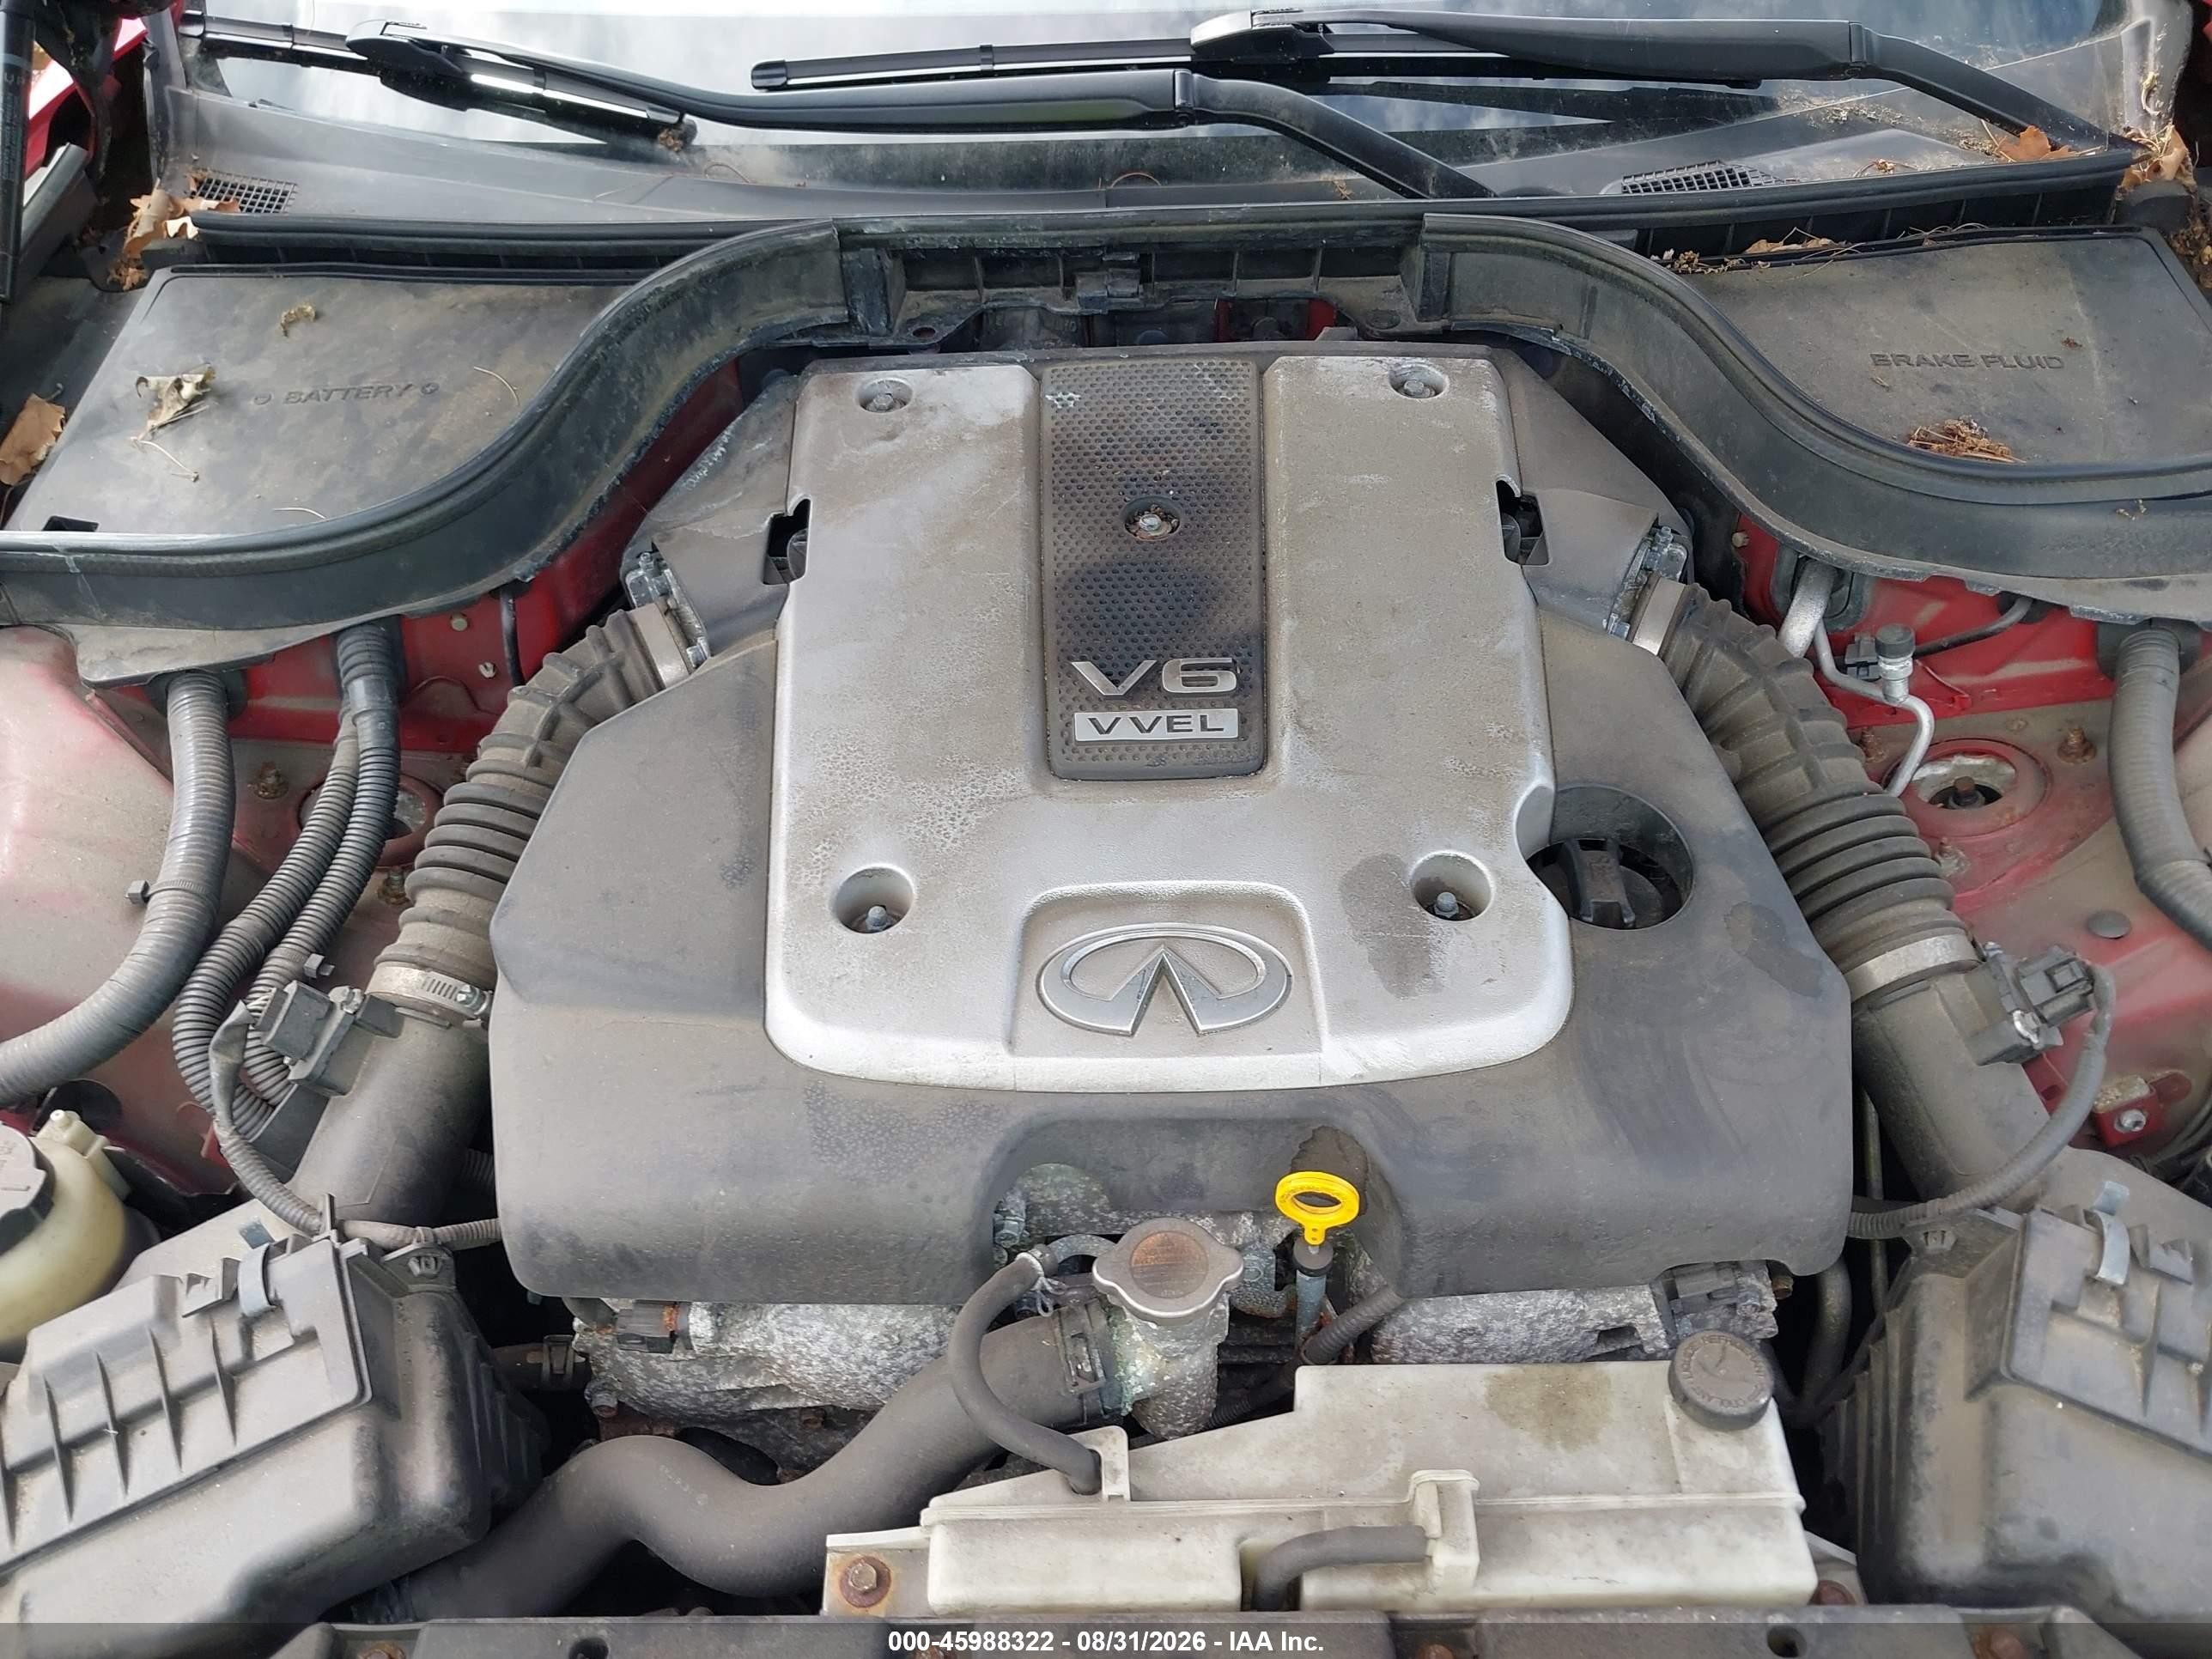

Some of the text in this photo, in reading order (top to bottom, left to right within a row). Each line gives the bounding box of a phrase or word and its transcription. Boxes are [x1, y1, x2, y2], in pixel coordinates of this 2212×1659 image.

[1869, 352, 2065, 370] BRAKE FLUID
[283, 383, 413, 405] BATTERY
[1071, 657, 1239, 699] V6
[1086, 714, 1225, 736] VVEL
